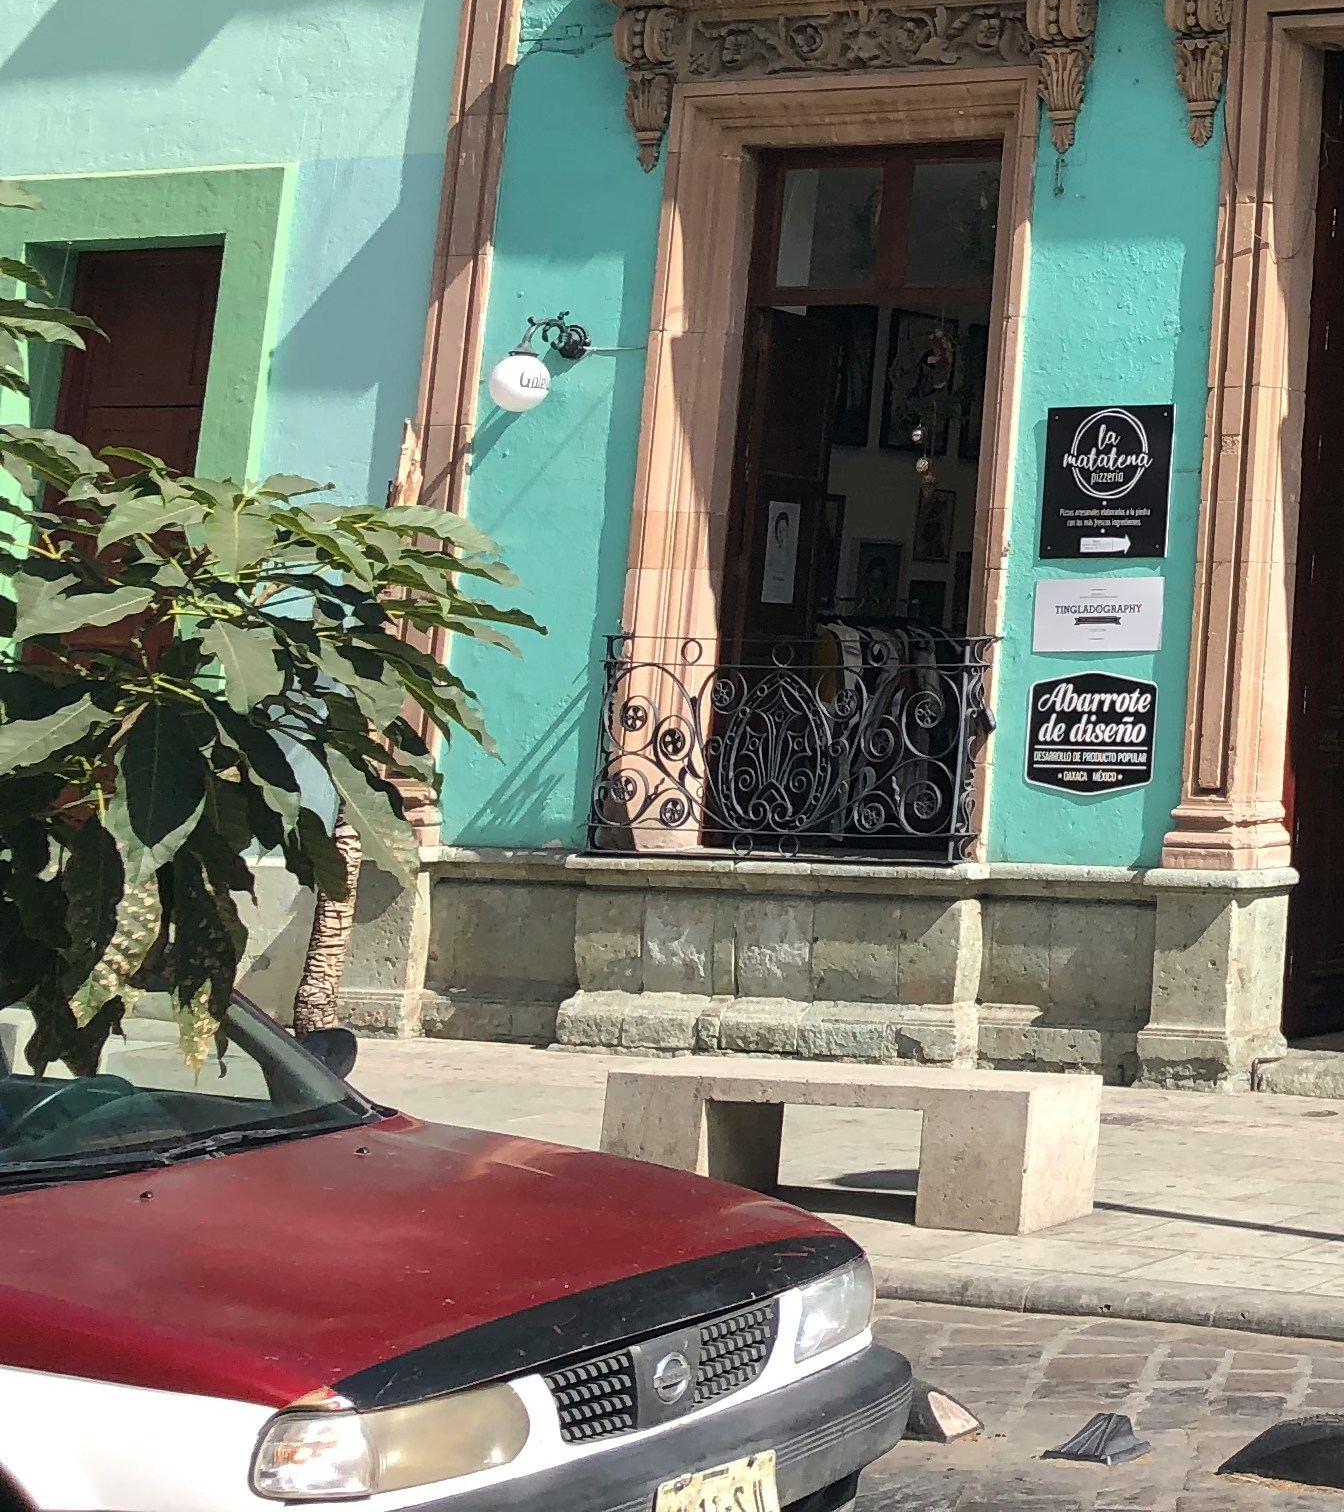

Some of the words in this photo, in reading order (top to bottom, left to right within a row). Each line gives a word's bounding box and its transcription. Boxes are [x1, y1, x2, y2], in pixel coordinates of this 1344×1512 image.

[1098, 424, 1121, 449] la
[1063, 447, 1153, 470] matatena
[1038, 683, 1152, 713] Abarrote
[1038, 713, 1067, 742] de
[1069, 713, 1147, 743] diseño
[1034, 751, 1072, 762] DESARROLLO
[1073, 752, 1082, 762] DE
[1118, 753, 1147, 763] POPULAR
[1063, 771, 1088, 781] OAXACA
